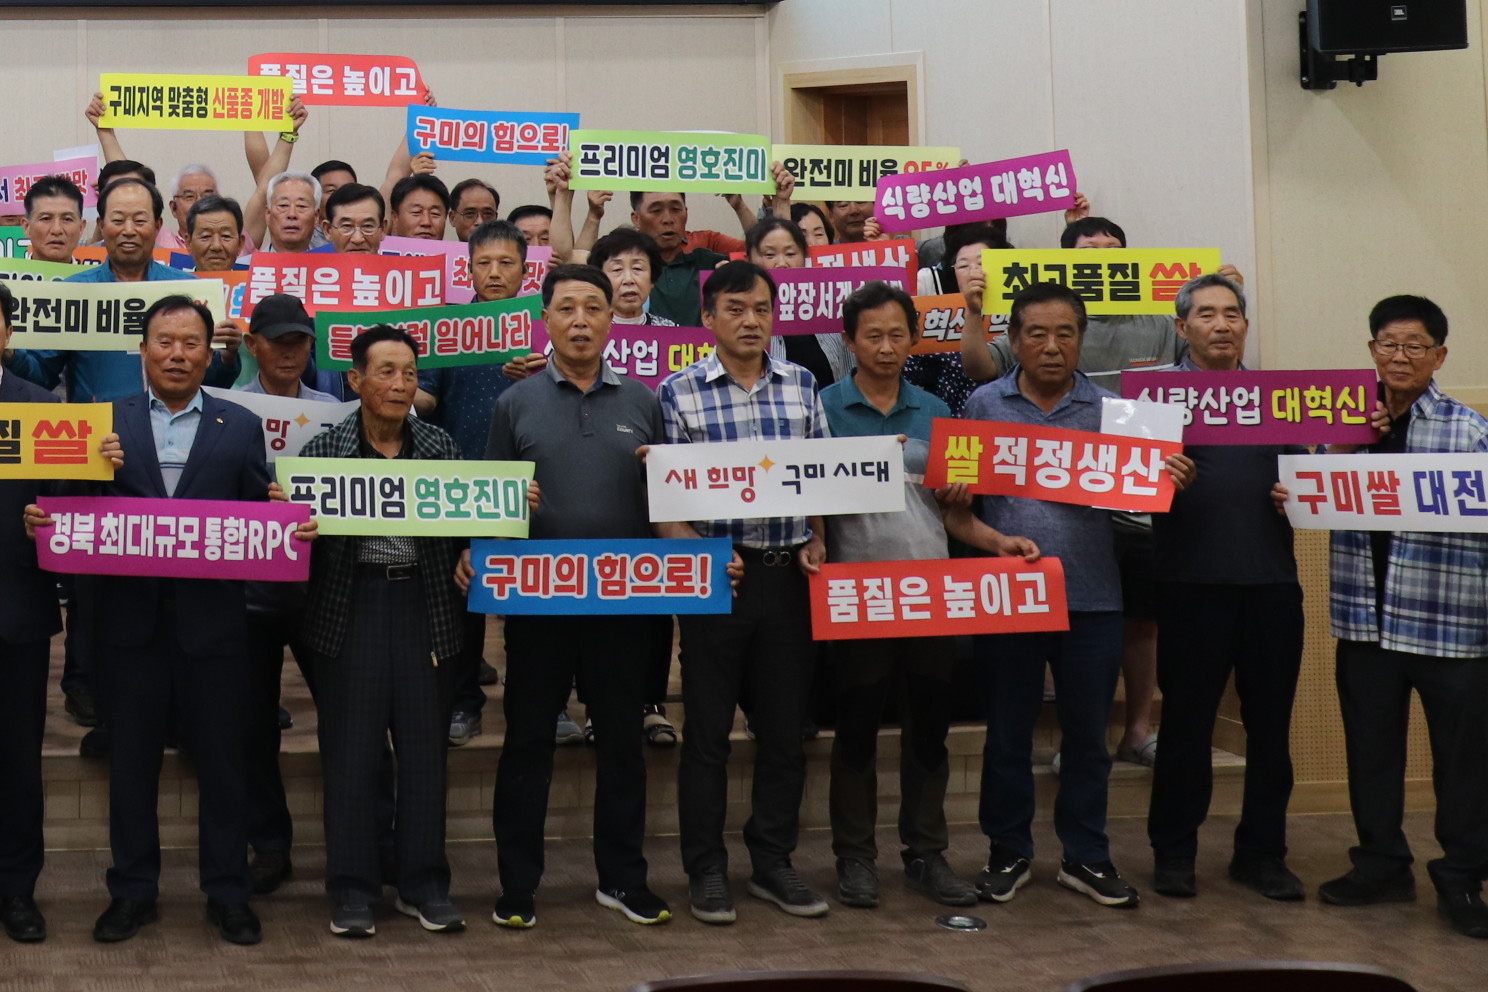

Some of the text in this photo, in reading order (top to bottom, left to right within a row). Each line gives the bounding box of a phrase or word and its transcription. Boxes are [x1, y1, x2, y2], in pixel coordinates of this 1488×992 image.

[342, 64, 418, 97] 높이고
[109, 85, 285, 120] 구미지역 맞춤형 신품종 개발
[414, 116, 568, 153] 구미의 힘으로!
[578, 143, 767, 182] 프리미엄 영호진미
[782, 157, 853, 188] 완전미
[881, 161, 1071, 221] 식량산업 대혁신
[249, 265, 341, 306] 품질은
[351, 267, 443, 307] 높이고
[1149, 261, 1202, 302] 쌀
[11, 297, 146, 336] 완전미 비율
[434, 310, 532, 355] 일어나라
[1271, 384, 1368, 425] 대혁신
[31, 419, 93, 466] 쌀
[944, 435, 1168, 497] 쌀 적정생산
[289, 476, 528, 521] 프리미엄 영호진미
[1295, 470, 1403, 516] 구미쌀
[49, 511, 299, 562] 경북 최대규모 통합RPC
[485, 554, 711, 599] 구미의 힘으로!
[827, 571, 1051, 624] 품질은 높이고
